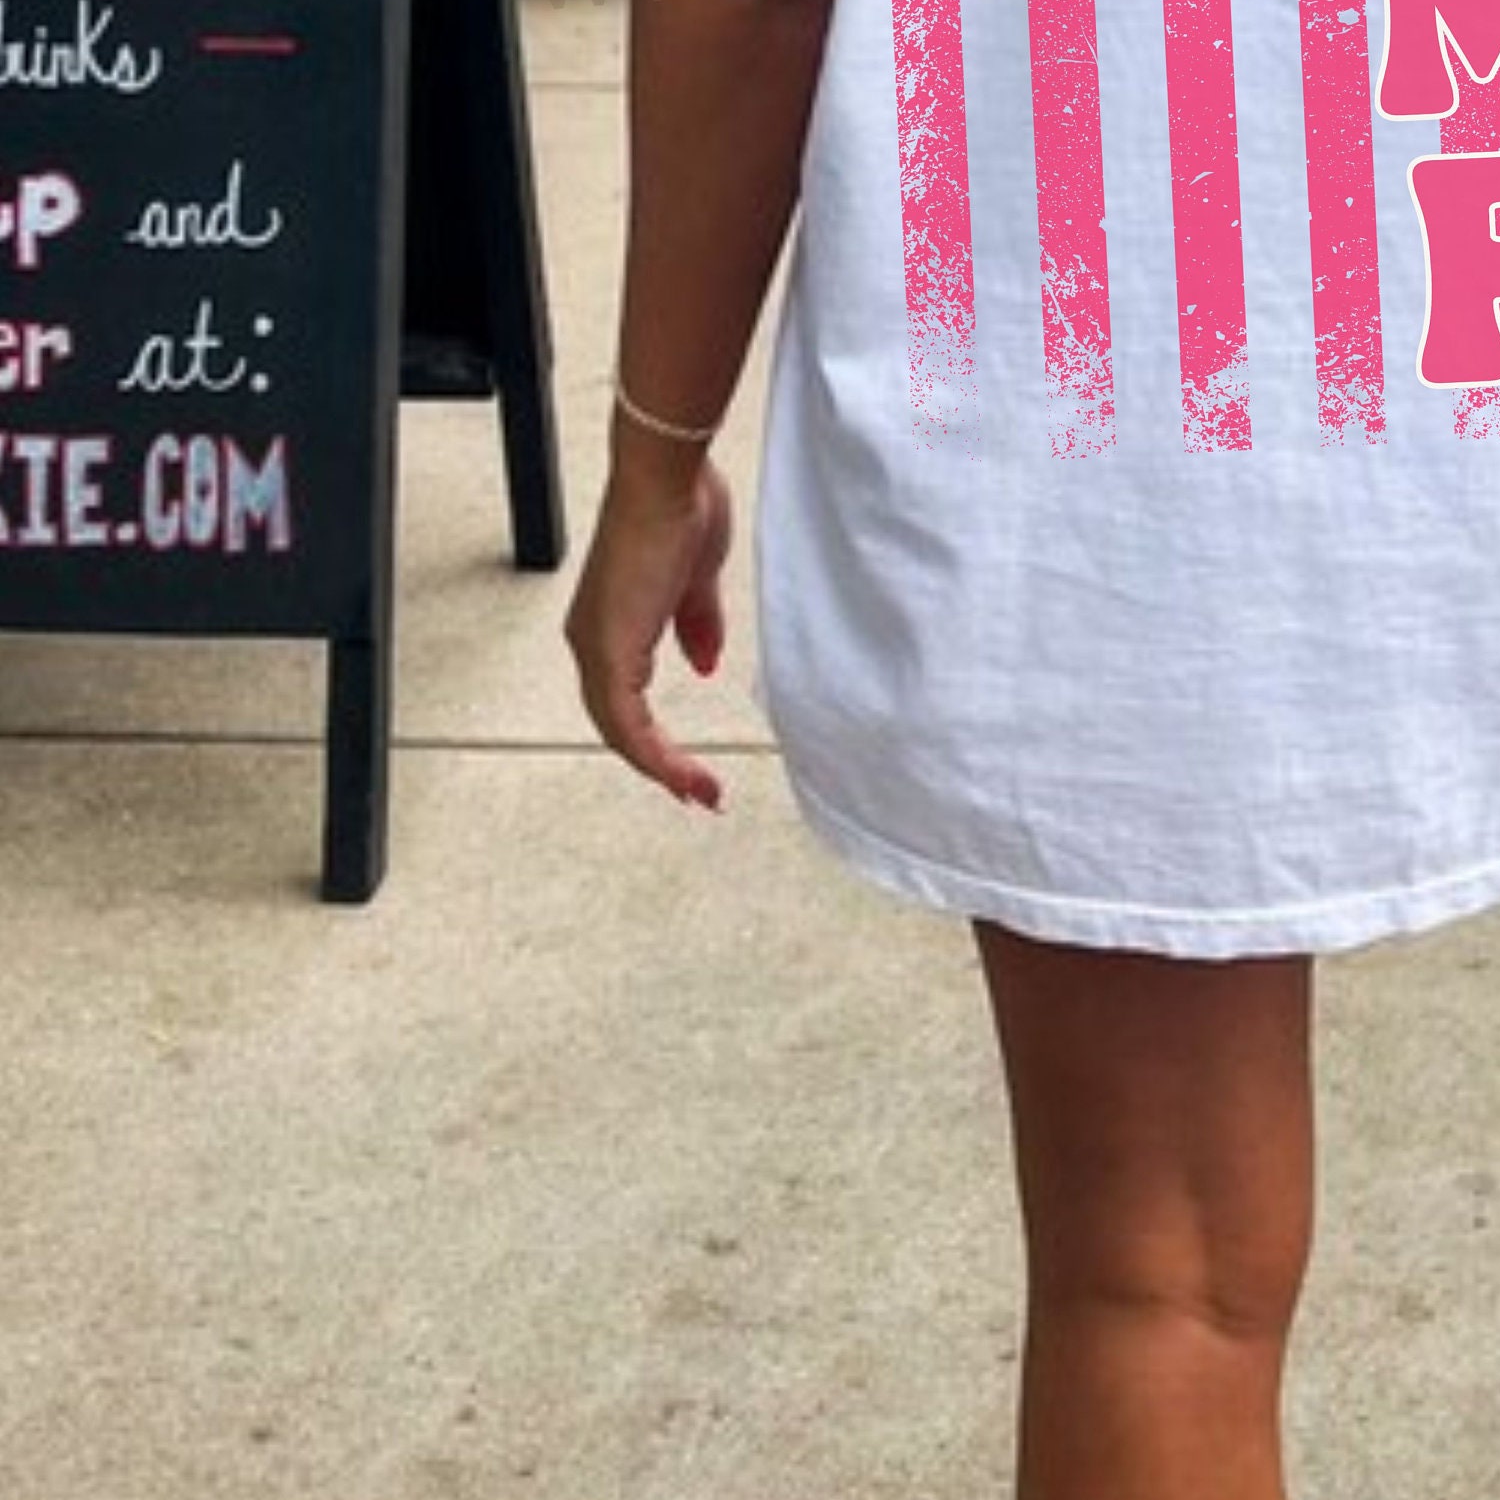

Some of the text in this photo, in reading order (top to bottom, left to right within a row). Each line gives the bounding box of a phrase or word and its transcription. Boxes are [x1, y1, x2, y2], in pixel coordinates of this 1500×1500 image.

[124, 158, 284, 250] and
[117, 298, 275, 393] at:
[0, 432, 291, 553] IE.COM
